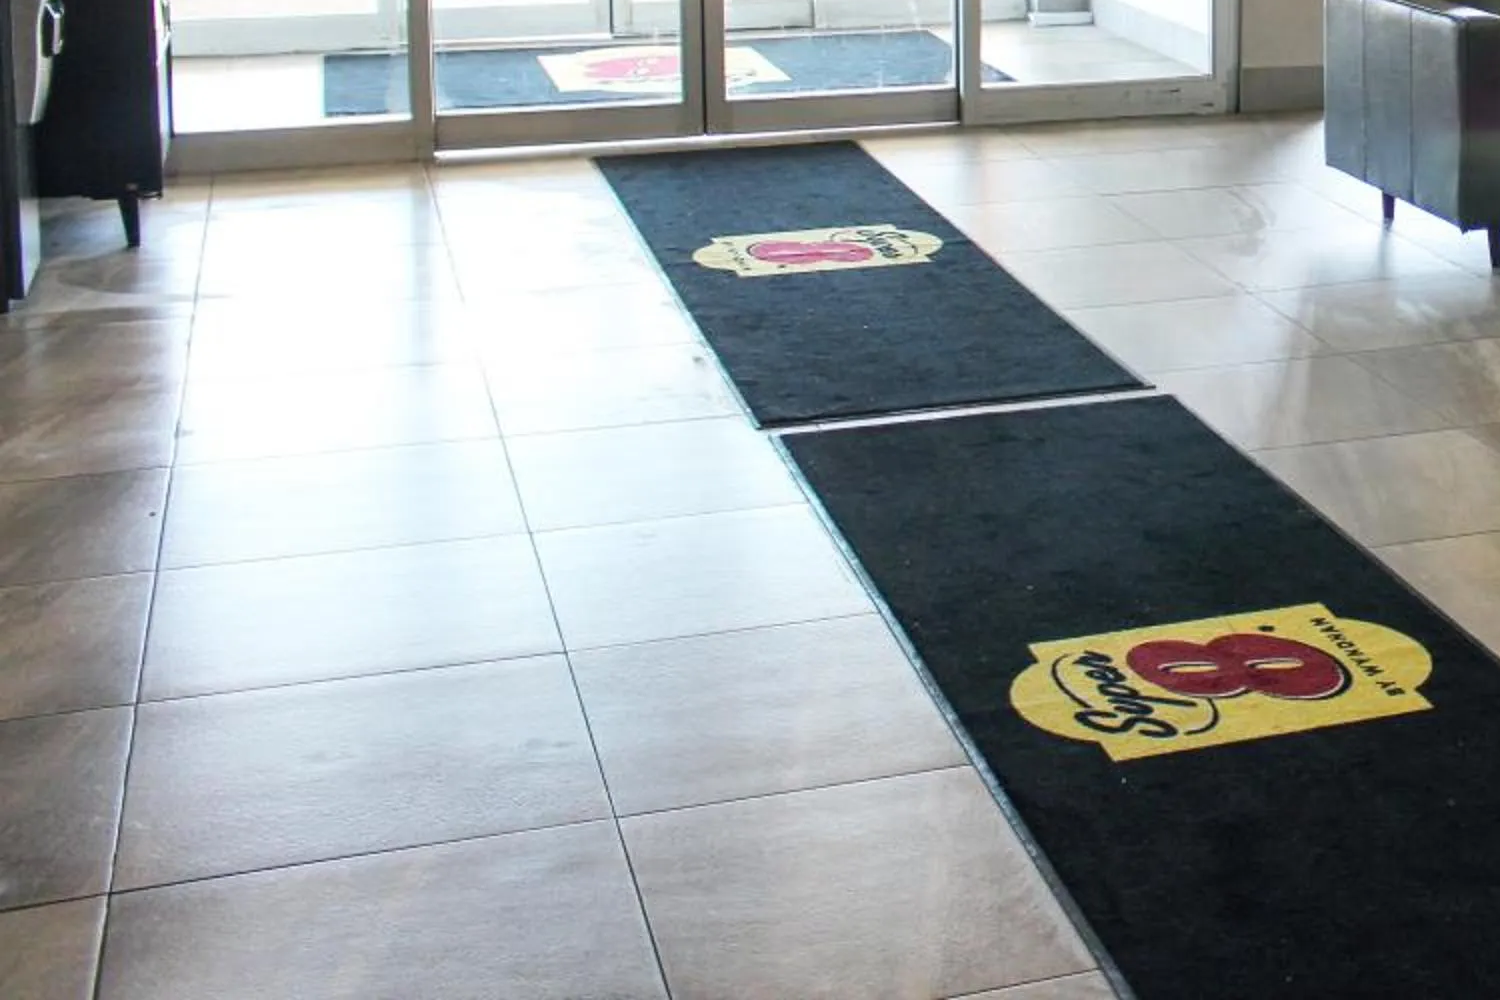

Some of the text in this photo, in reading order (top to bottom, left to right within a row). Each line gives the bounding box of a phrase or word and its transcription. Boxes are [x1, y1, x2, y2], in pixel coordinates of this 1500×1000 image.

[1072, 649, 1198, 738] Super
[1126, 633, 1352, 701] 8
[1375, 681, 1405, 697] BY
